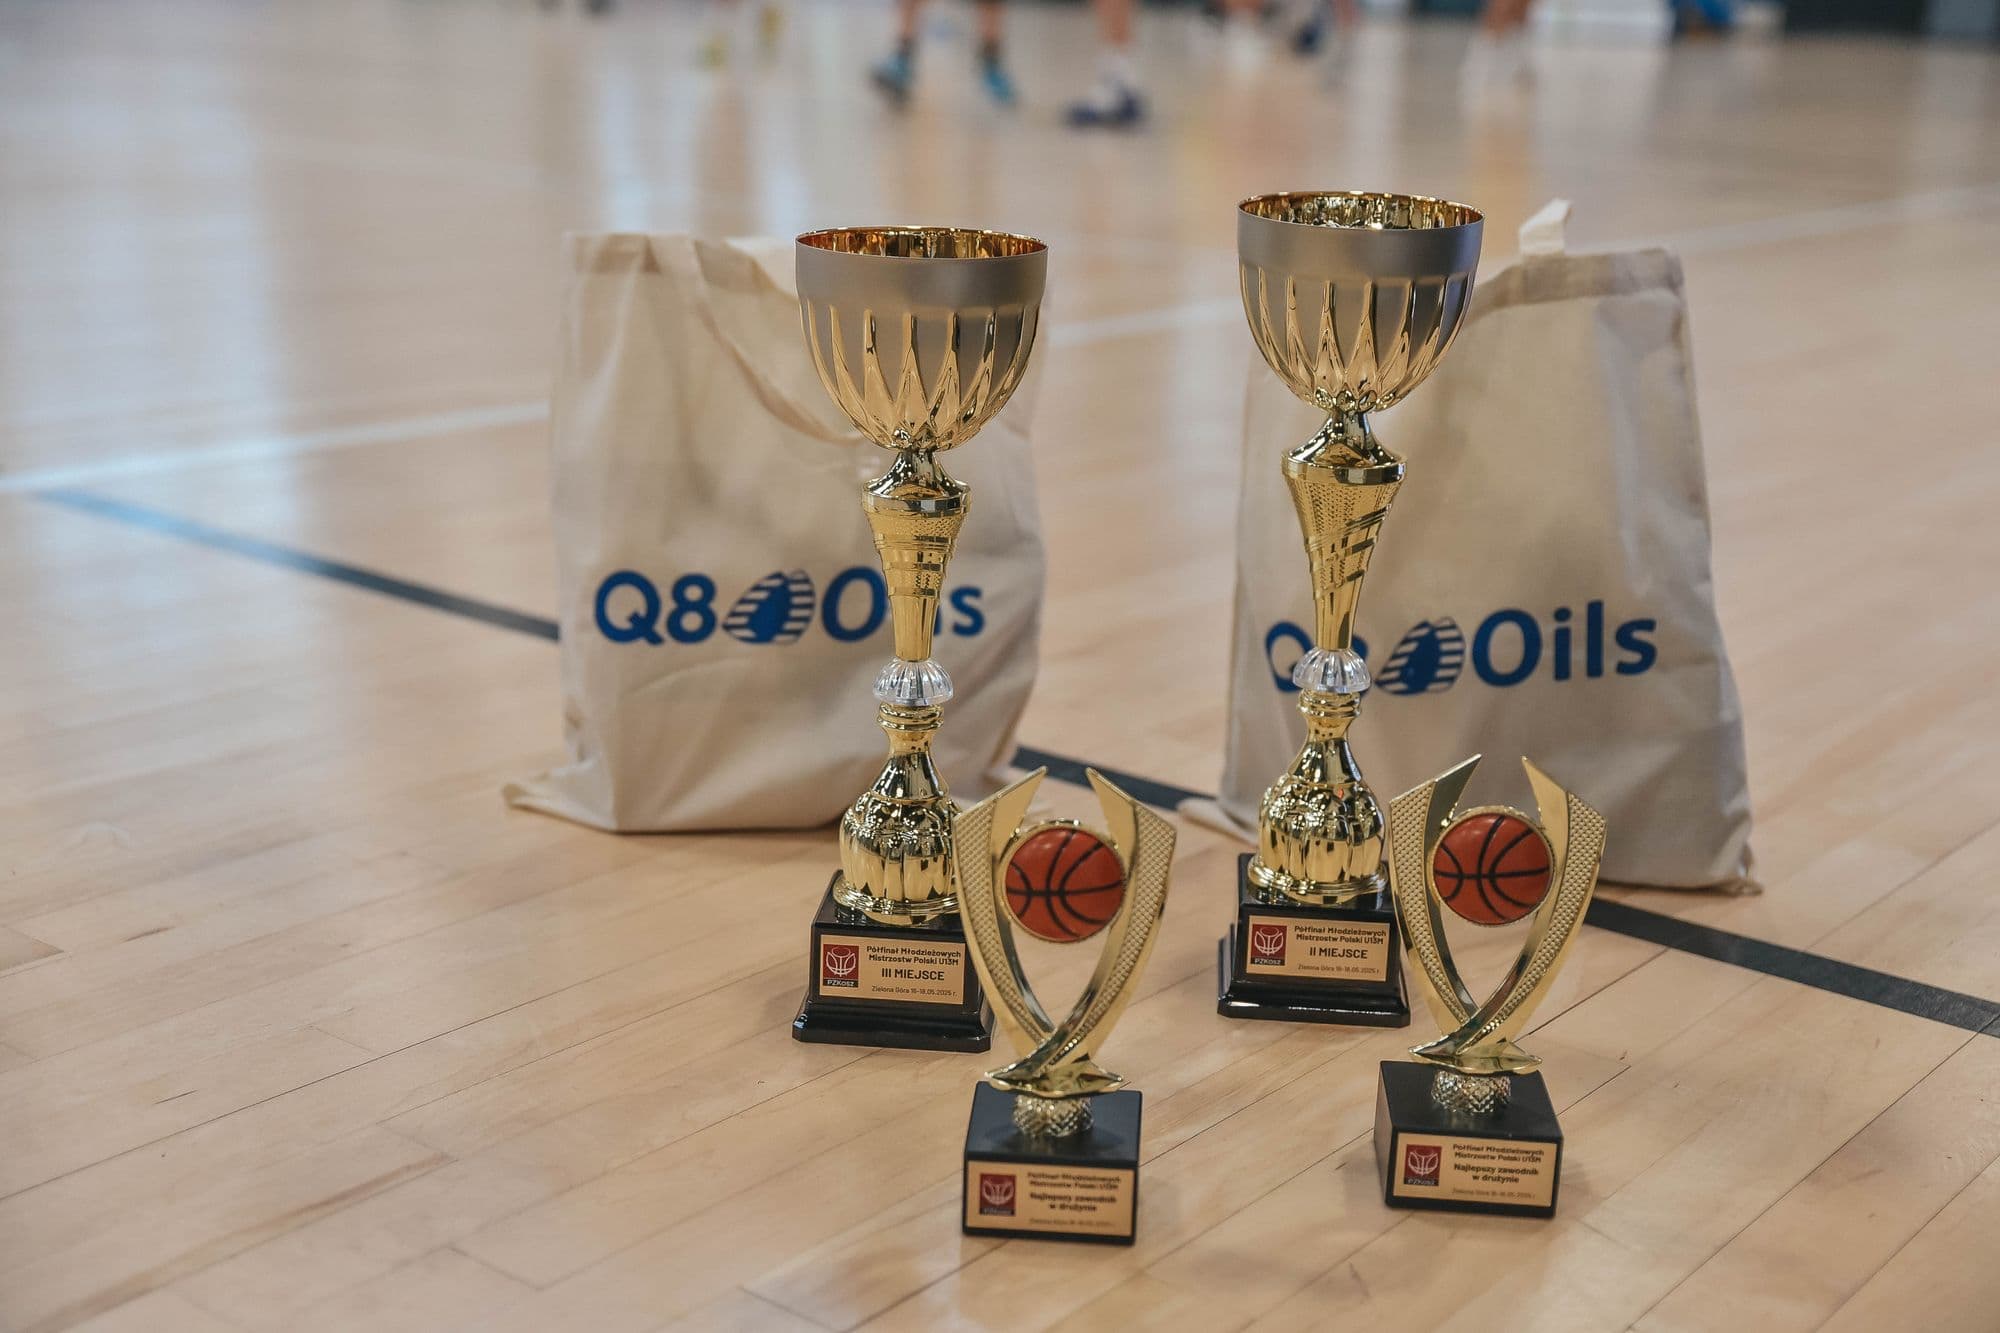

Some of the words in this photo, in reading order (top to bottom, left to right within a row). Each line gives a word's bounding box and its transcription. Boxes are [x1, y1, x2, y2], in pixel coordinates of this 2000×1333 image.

[594, 569, 717, 646] Q8
[820, 565, 986, 644] Os
[1471, 599, 1658, 688] Oils
[1294, 925, 1326, 934] Półfinał
[1328, 927, 1387, 938] Młodzieżowych
[1296, 934, 1339, 942] Mistrzostw
[1339, 936, 1363, 944] Polski
[1364, 937, 1384, 945] U13M
[866, 945, 899, 954] Półfinał
[900, 947, 961, 958] Młodzieżowych
[1309, 947, 1317, 956] II
[1319, 947, 1369, 959] MIEJSCE
[868, 954, 913, 964] Mistrzostw
[913, 957, 938, 965] Polski
[939, 958, 959, 966] U13M
[881, 967, 892, 978] III
[894, 968, 945, 981] MIEJSCE
[1454, 1163, 1496, 1174] Najlepszy
[1498, 1166, 1539, 1176] zawodnik
[1482, 1174, 1520, 1184] drużynie
